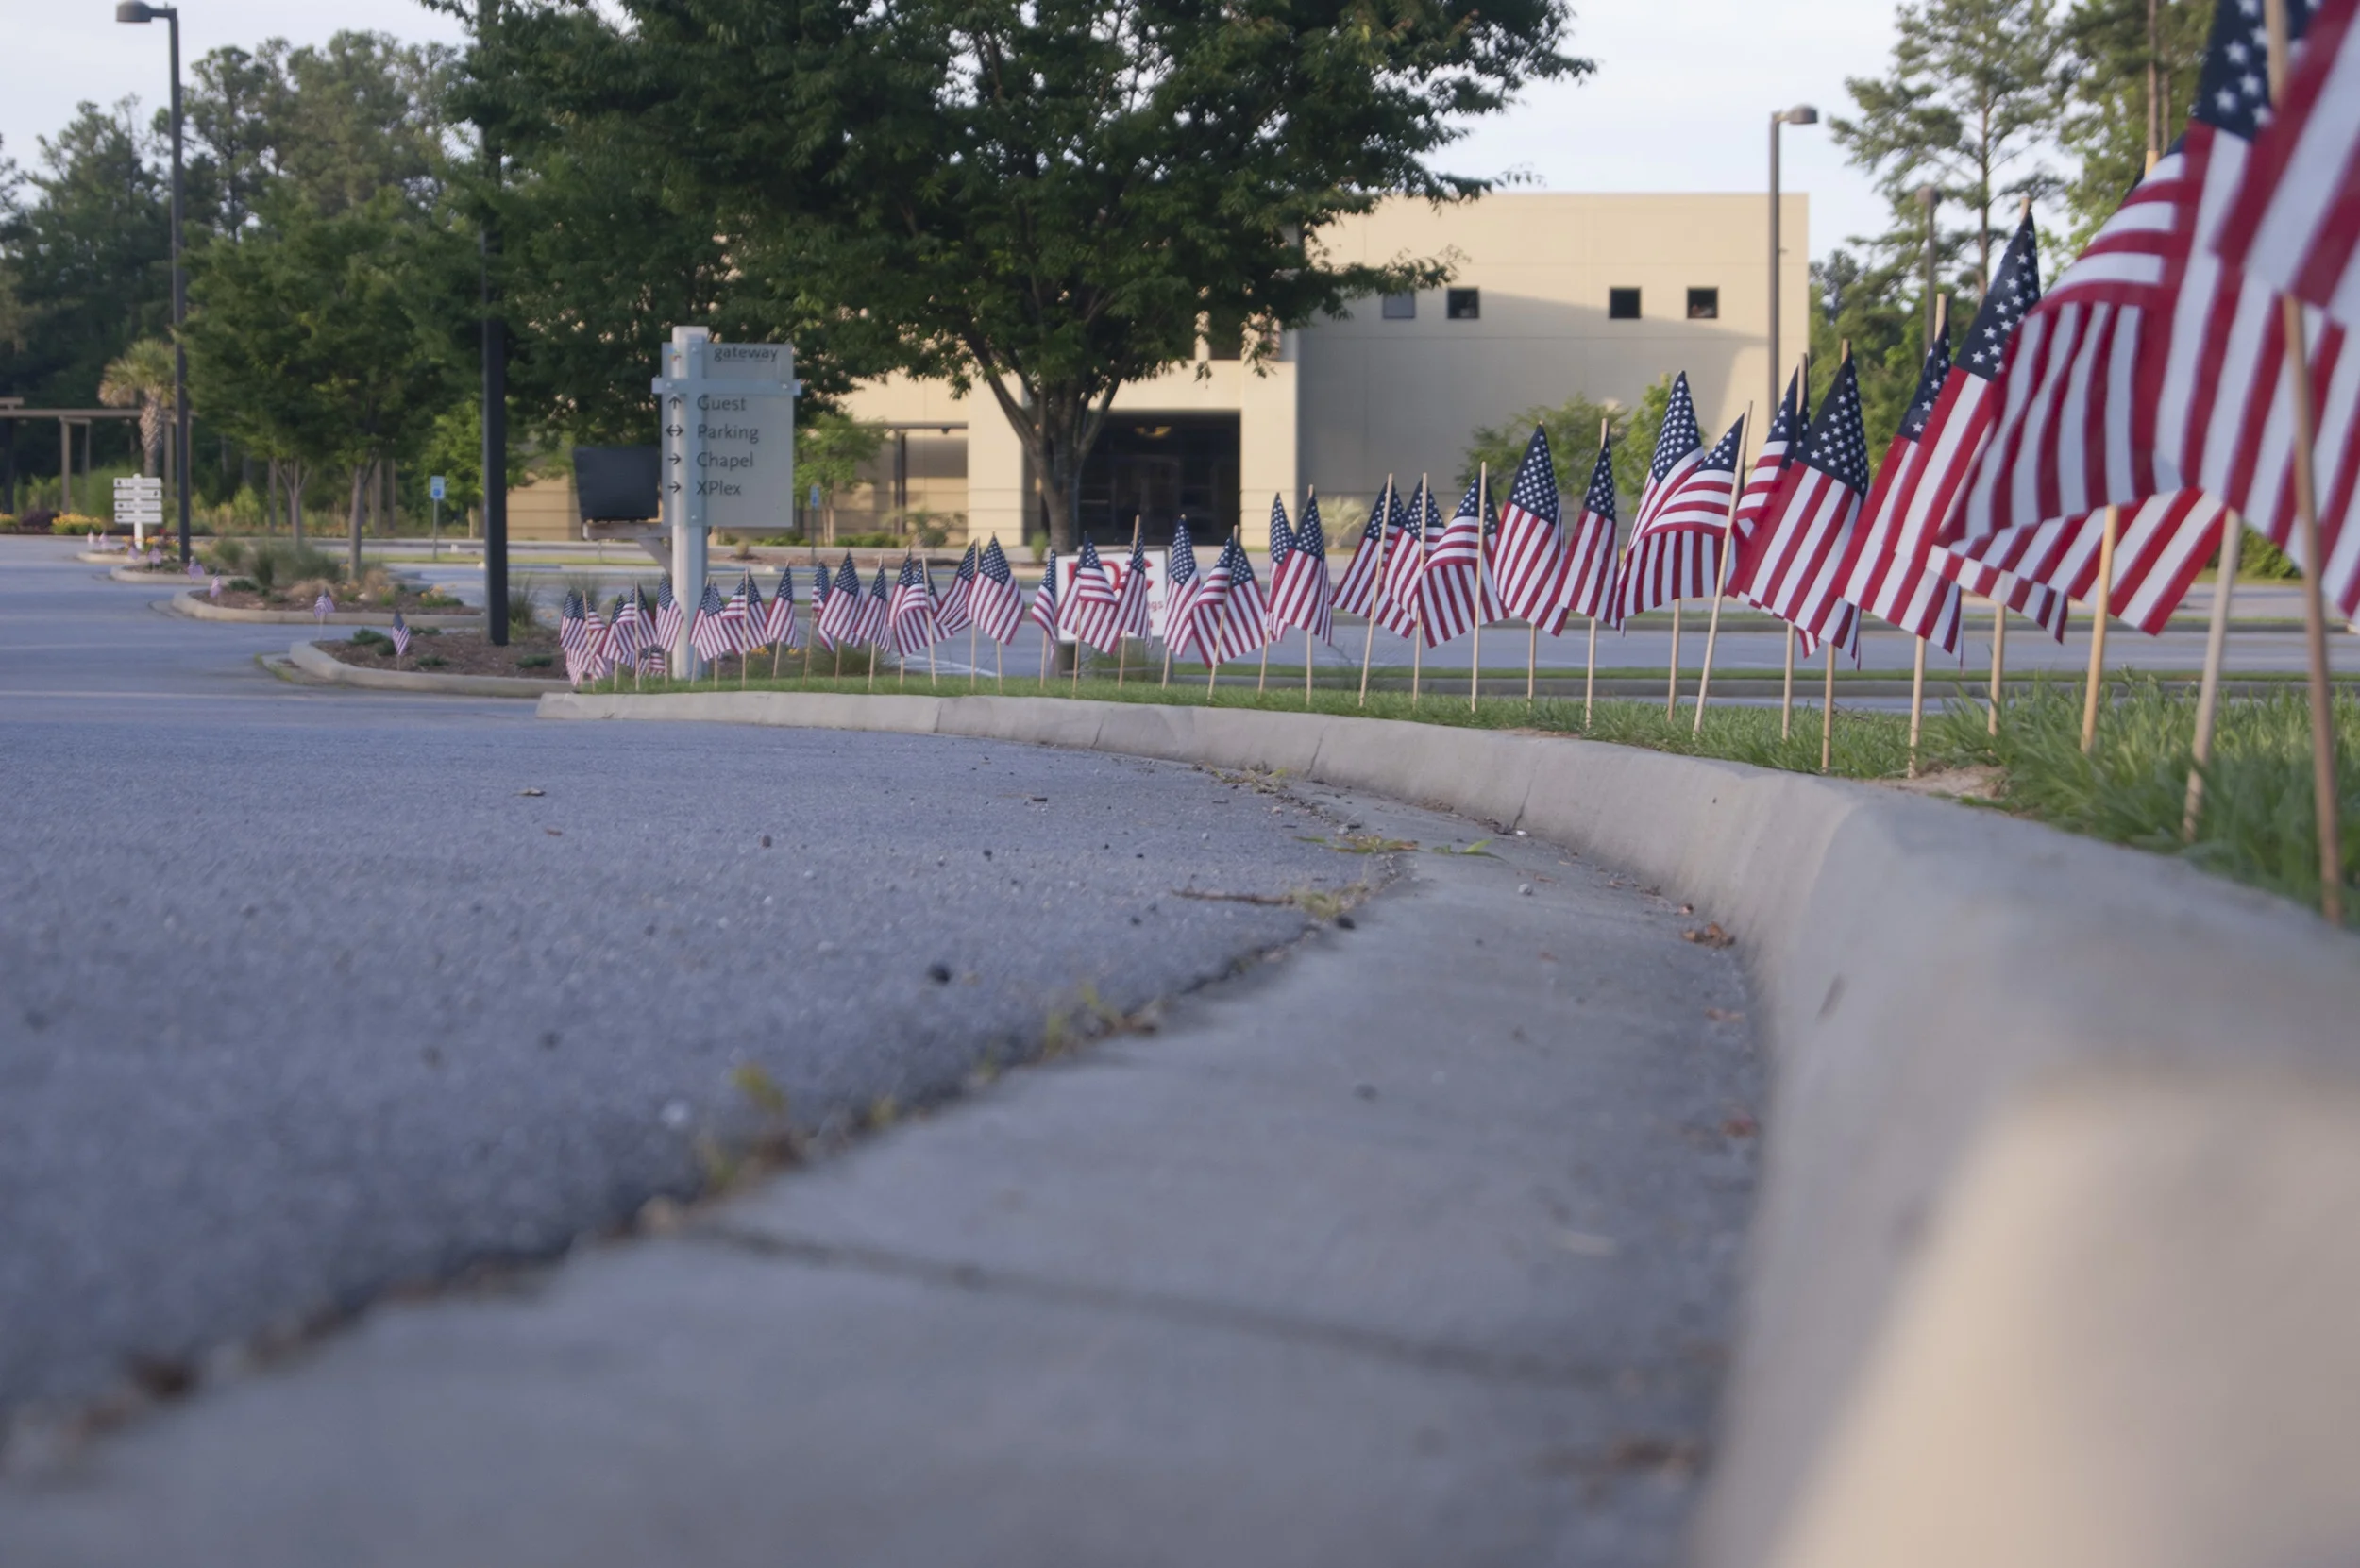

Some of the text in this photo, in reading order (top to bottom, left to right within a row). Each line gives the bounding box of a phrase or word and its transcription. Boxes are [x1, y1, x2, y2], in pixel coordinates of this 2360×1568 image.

[714, 346, 778, 362] gateway
[697, 395, 746, 411] Guest
[698, 424, 759, 444] Parking
[697, 451, 754, 470] Chapel
[696, 481, 741, 496] XPlex
